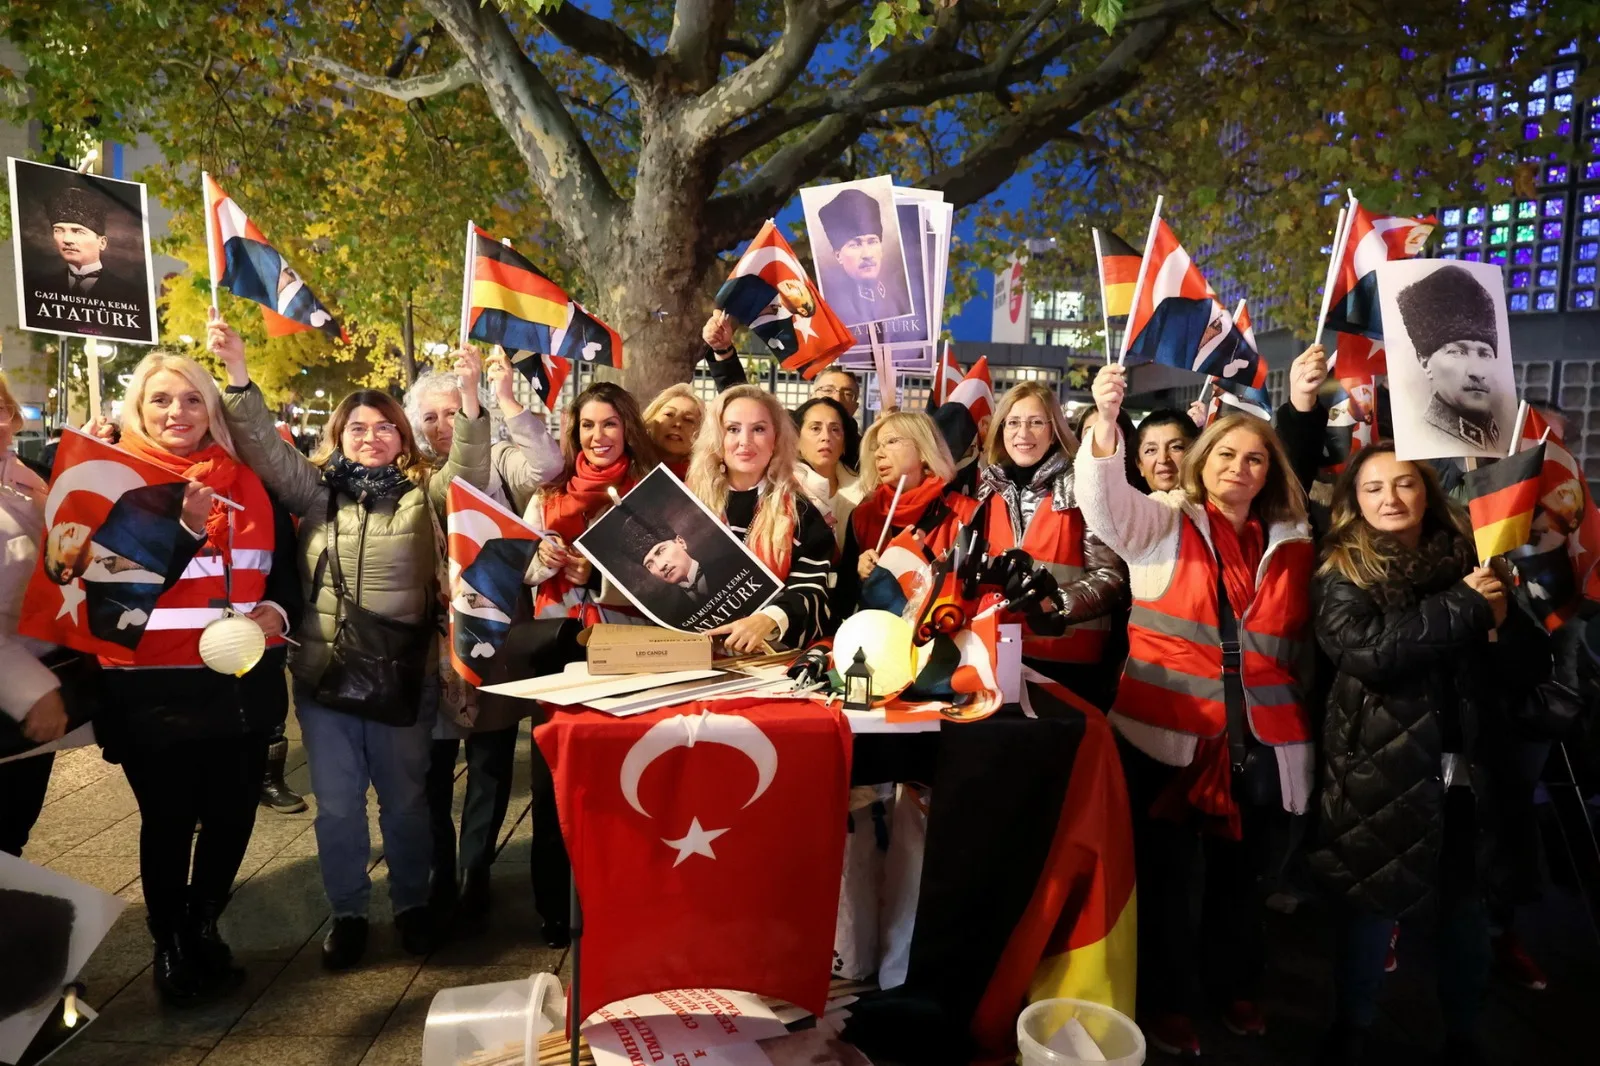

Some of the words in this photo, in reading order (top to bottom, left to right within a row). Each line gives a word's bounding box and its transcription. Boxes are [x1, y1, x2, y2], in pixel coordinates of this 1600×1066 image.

[34, 290, 58, 301] GAZİ
[60, 294, 106, 308] MUSTAFA
[107, 301, 140, 312] KEMAL
[37, 302, 141, 329] ATATÜRK
[693, 575, 763, 633] ATATÜRK
[696, 589, 729, 618] MUSTAFA
[725, 568, 750, 591] KEMAL
